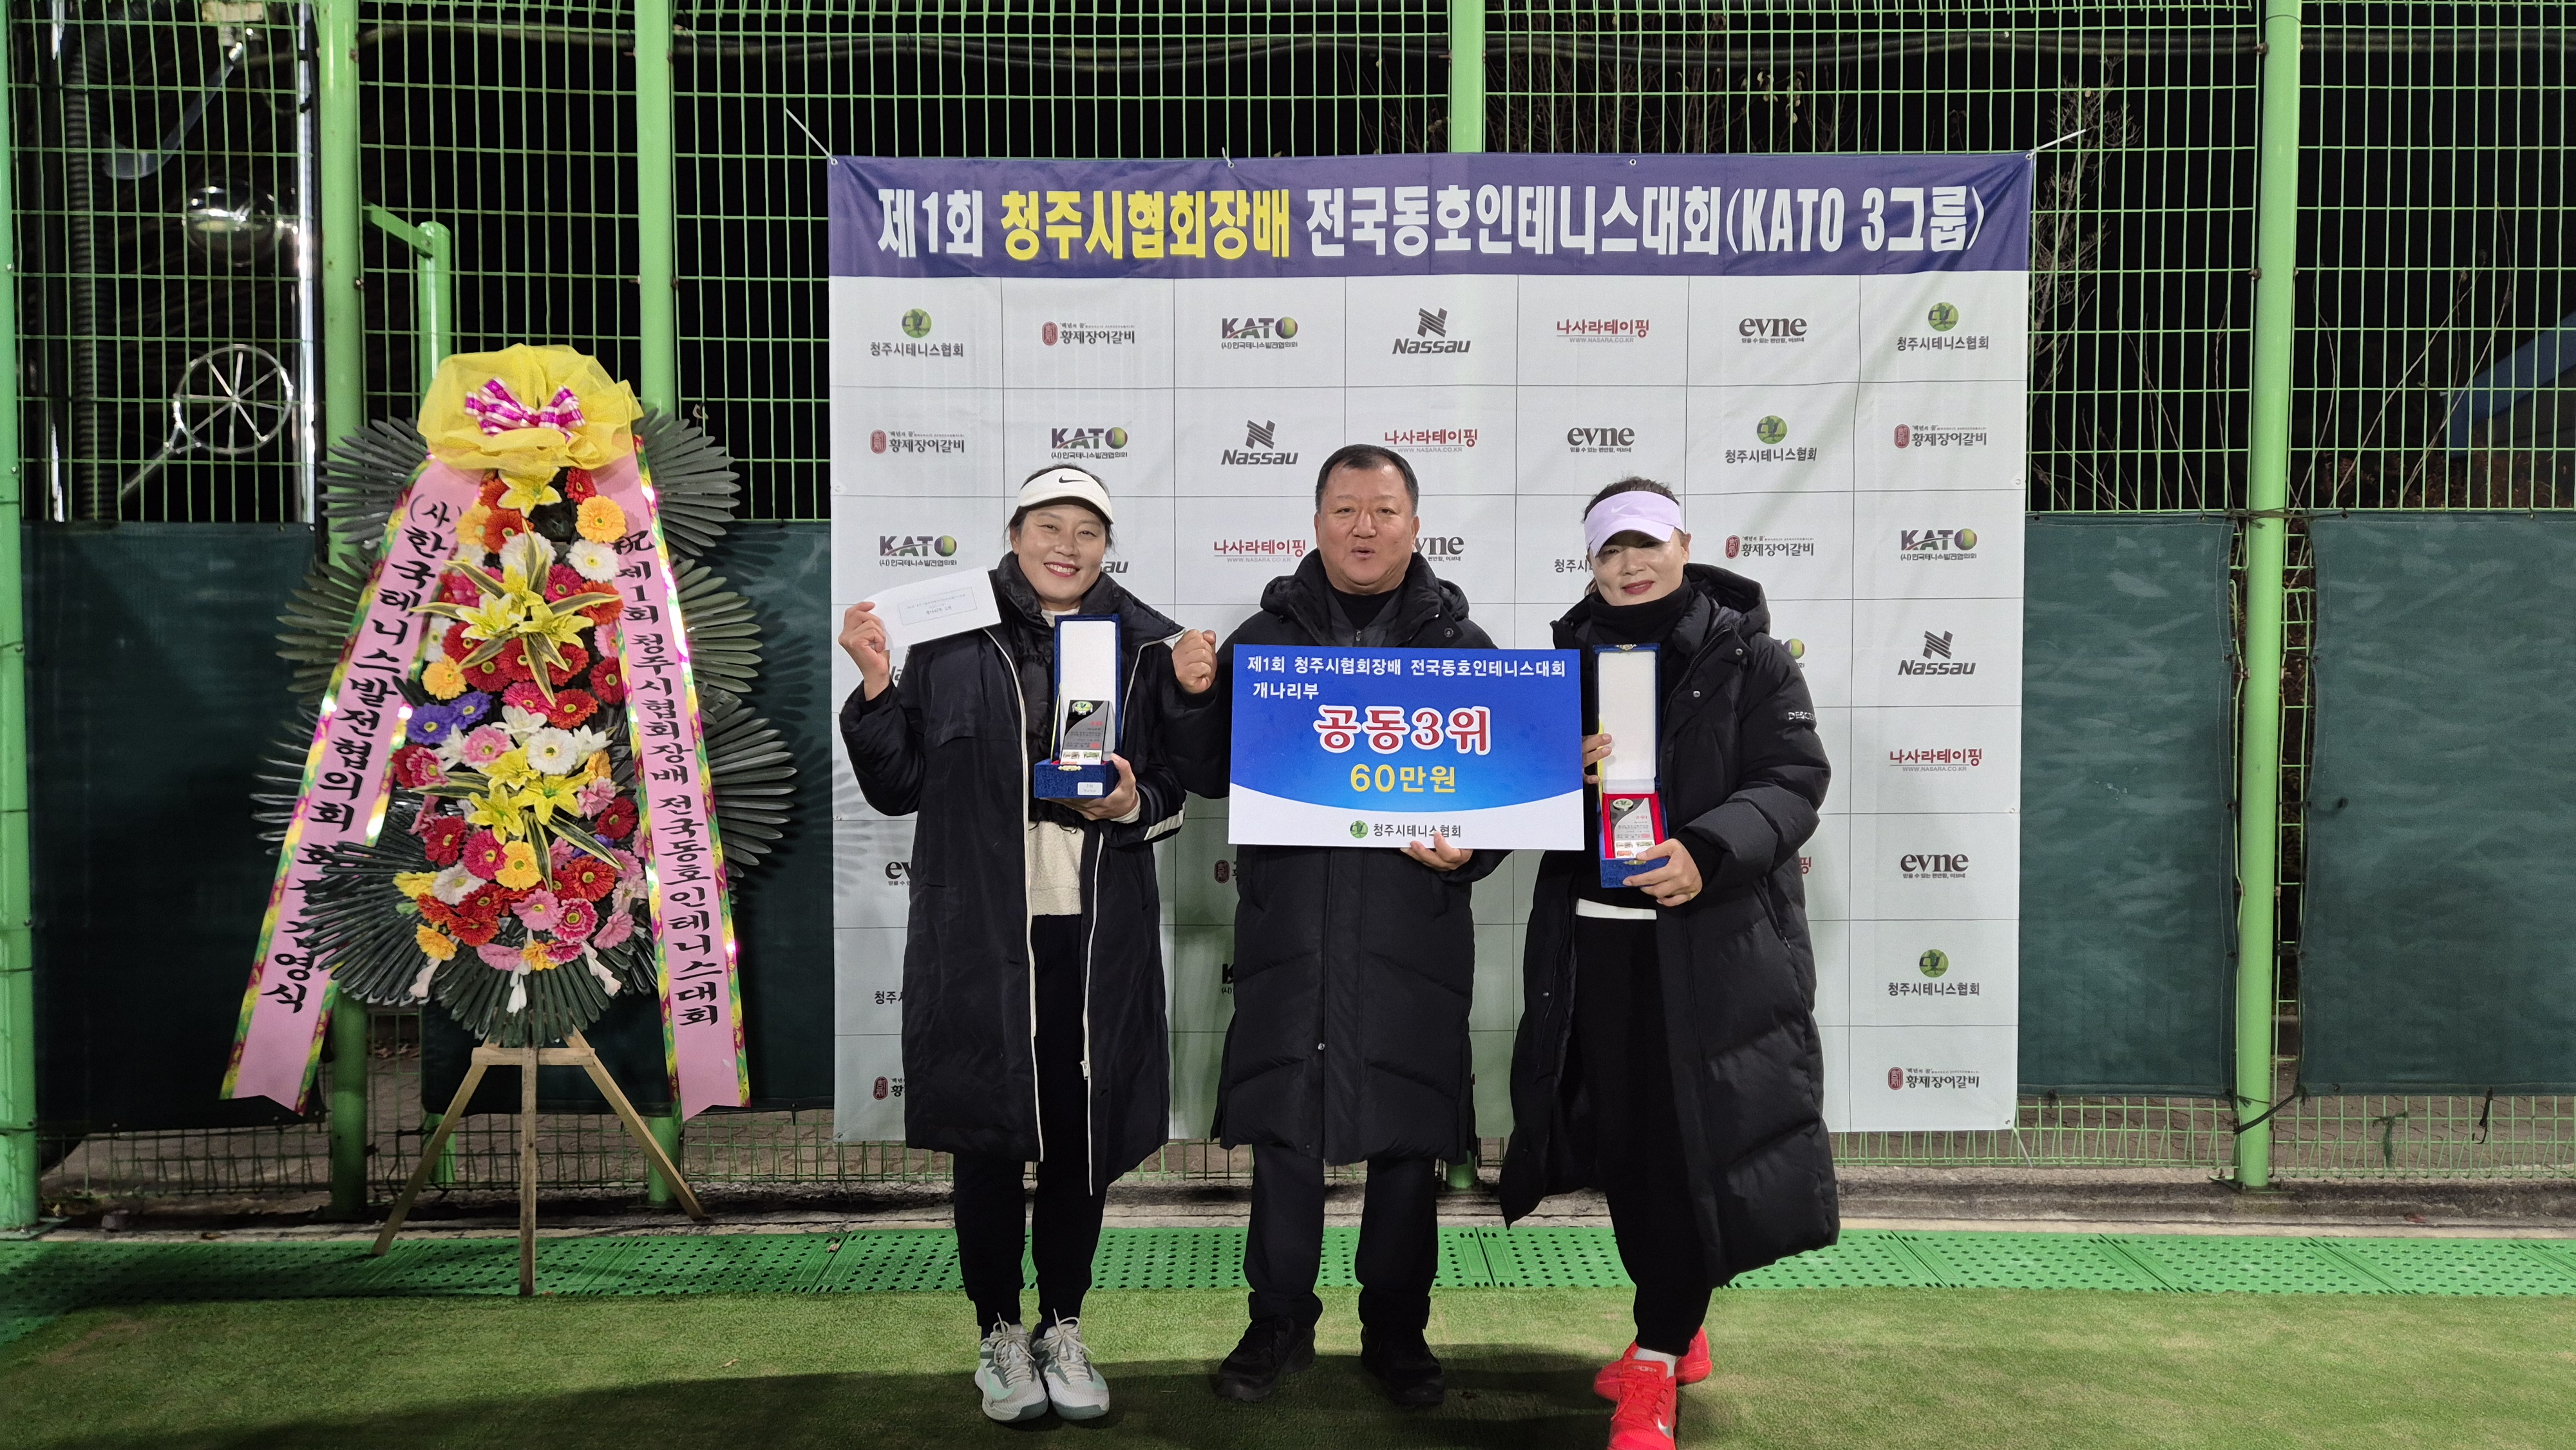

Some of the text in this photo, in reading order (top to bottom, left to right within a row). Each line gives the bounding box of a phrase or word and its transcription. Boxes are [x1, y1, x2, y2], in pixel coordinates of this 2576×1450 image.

[877, 188, 983, 257] 제1회
[1001, 189, 1289, 260] 청주시협회장배
[1861, 185, 1985, 252] 3그룹)
[1557, 319, 1649, 338] 나사라테이핑
[1739, 317, 1808, 337] evne
[1060, 330, 1135, 344] 황제장어갈비
[1897, 335, 1989, 351] 청주시테니스협회
[870, 342, 963, 357] 청주시테니스협회
[1392, 338, 1471, 354] Nassau
[889, 438, 965, 453] 황제장어갈비
[1384, 429, 1477, 447] 나사라테이핑
[1567, 428, 1635, 446] evne
[1911, 432, 1987, 447] 황제장어갈비
[1220, 449, 1299, 465] Nassau
[1725, 447, 1817, 464] 청주시테니스협회
[1214, 540, 1306, 557] 나사라테이핑
[1414, 536, 1464, 555] vne
[1741, 542, 1814, 557] 황제장어갈비
[1247, 655, 1566, 677] 제1회 청주시협회장배 전국동호인테니스대회
[1897, 659, 1976, 675] Nassau
[1253, 682, 1319, 700] 개나리부
[1314, 706, 1490, 754] 공동3위
[1889, 748, 1982, 767] 나사라테이핑
[1350, 763, 1456, 793] 60만원
[616, 561, 723, 1026] 제1회 청주시협회장배 전국동호인테니스대회
[1373, 824, 1461, 838] 청주시테니스협회
[885, 862, 911, 880] ev
[1900, 854, 1969, 872] evne
[1888, 982, 1980, 996] 청주시테니스협회
[1906, 1075, 1980, 1089] 황제장어갈비
